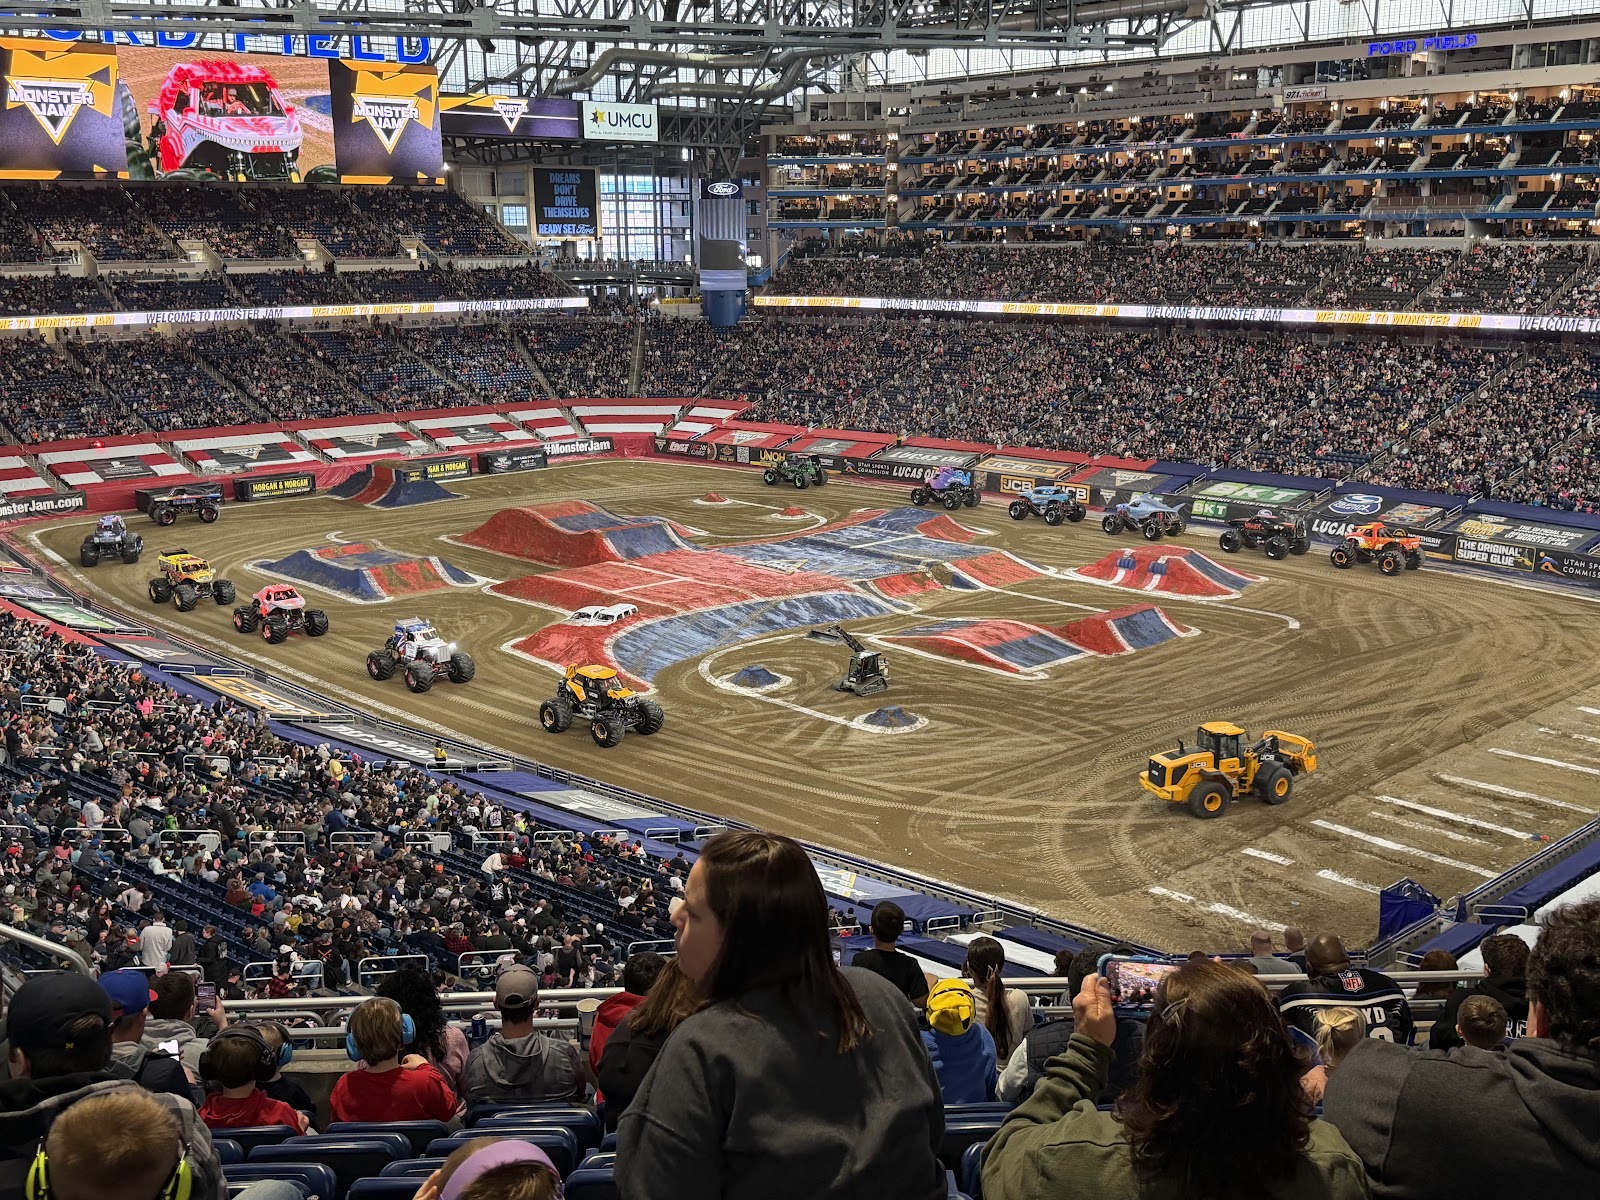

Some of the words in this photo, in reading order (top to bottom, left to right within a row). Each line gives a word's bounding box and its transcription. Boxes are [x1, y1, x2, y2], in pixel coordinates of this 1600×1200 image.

[1368, 40, 1417, 56] FORD
[1424, 34, 1477, 51] FIELD
[9, 89, 95, 105] MONSTER
[35, 103, 74, 116] JAM
[354, 105, 419, 119] MONSTER
[493, 104, 529, 113] MONSTER
[373, 117, 404, 129] JAM
[608, 112, 652, 128] UMCU
[549, 172, 580, 184] DREAMS
[554, 185, 577, 195] DON'T
[714, 184, 733, 193] Ford
[555, 196, 577, 206] DRIVE
[543, 207, 590, 218] THEMSELVES
[539, 224, 562, 234] READY
[563, 224, 576, 234] SET
[576, 224, 596, 234] Ford
[459, 301, 497, 311] WELCOME
[499, 300, 508, 310] TO
[510, 299, 545, 309] MONSTER
[548, 299, 564, 308] JAM
[755, 297, 793, 306] WELCOME
[795, 298, 806, 306] TO
[808, 298, 845, 307] MONSTER
[848, 299, 861, 307] JAM
[880, 299, 914, 309] WELCOME
[915, 300, 924, 309] TO
[926, 300, 960, 311] MONSTER
[961, 301, 979, 311] JAM
[146, 311, 196, 324] WELCOME
[200, 310, 211, 321] TO
[213, 309, 259, 320] MONSTER
[263, 308, 283, 318] JAM
[312, 306, 356, 316] WELCOME
[359, 305, 371, 315] TO
[372, 305, 413, 314] MONSTER
[417, 304, 435, 312] JAM
[1002, 304, 1041, 314] WELCOME
[1043, 305, 1054, 314] TO
[1056, 305, 1097, 316] MONSTER
[1100, 306, 1119, 316] JAM
[1145, 306, 1191, 318] WELCOME
[1194, 308, 1206, 319] TO
[1208, 308, 1257, 320] MONSTER
[1259, 309, 1282, 320] JAM
[17, 319, 31, 329] TO
[34, 317, 88, 328] MONSTER
[92, 316, 115, 326] JAM
[1315, 311, 1371, 324] WELCOME
[1374, 313, 1389, 325] TO
[1391, 313, 1449, 327] MONSTER
[1452, 315, 1481, 328] JAM
[1520, 315, 1584, 331] WELCOME
[544, 441, 611, 455] #MonsterJam
[760, 450, 786, 461] UNOH
[889, 451, 941, 461] LUCAS
[445, 461, 467, 471] MORGAN
[892, 465, 923, 479] LUCAS
[984, 461, 1028, 471] JCB
[253, 482, 278, 493] MORGAN
[285, 478, 309, 489] MORGAN
[1003, 479, 1033, 493] JCB
[1203, 484, 1301, 502] BKT
[1193, 501, 1227, 516] BKT
[1312, 518, 1355, 538] LUCAS
[1531, 526, 1561, 535] OFFICIAL
[1459, 539, 1477, 551] THE
[1478, 543, 1522, 557] ORIGINAL
[1457, 549, 1489, 563] SUPER
[1490, 553, 1516, 567] GLUE
[1563, 558, 1586, 569] UTAH
[1191, 761, 1206, 769] JCB
[1345, 978, 1362, 989] NFL
